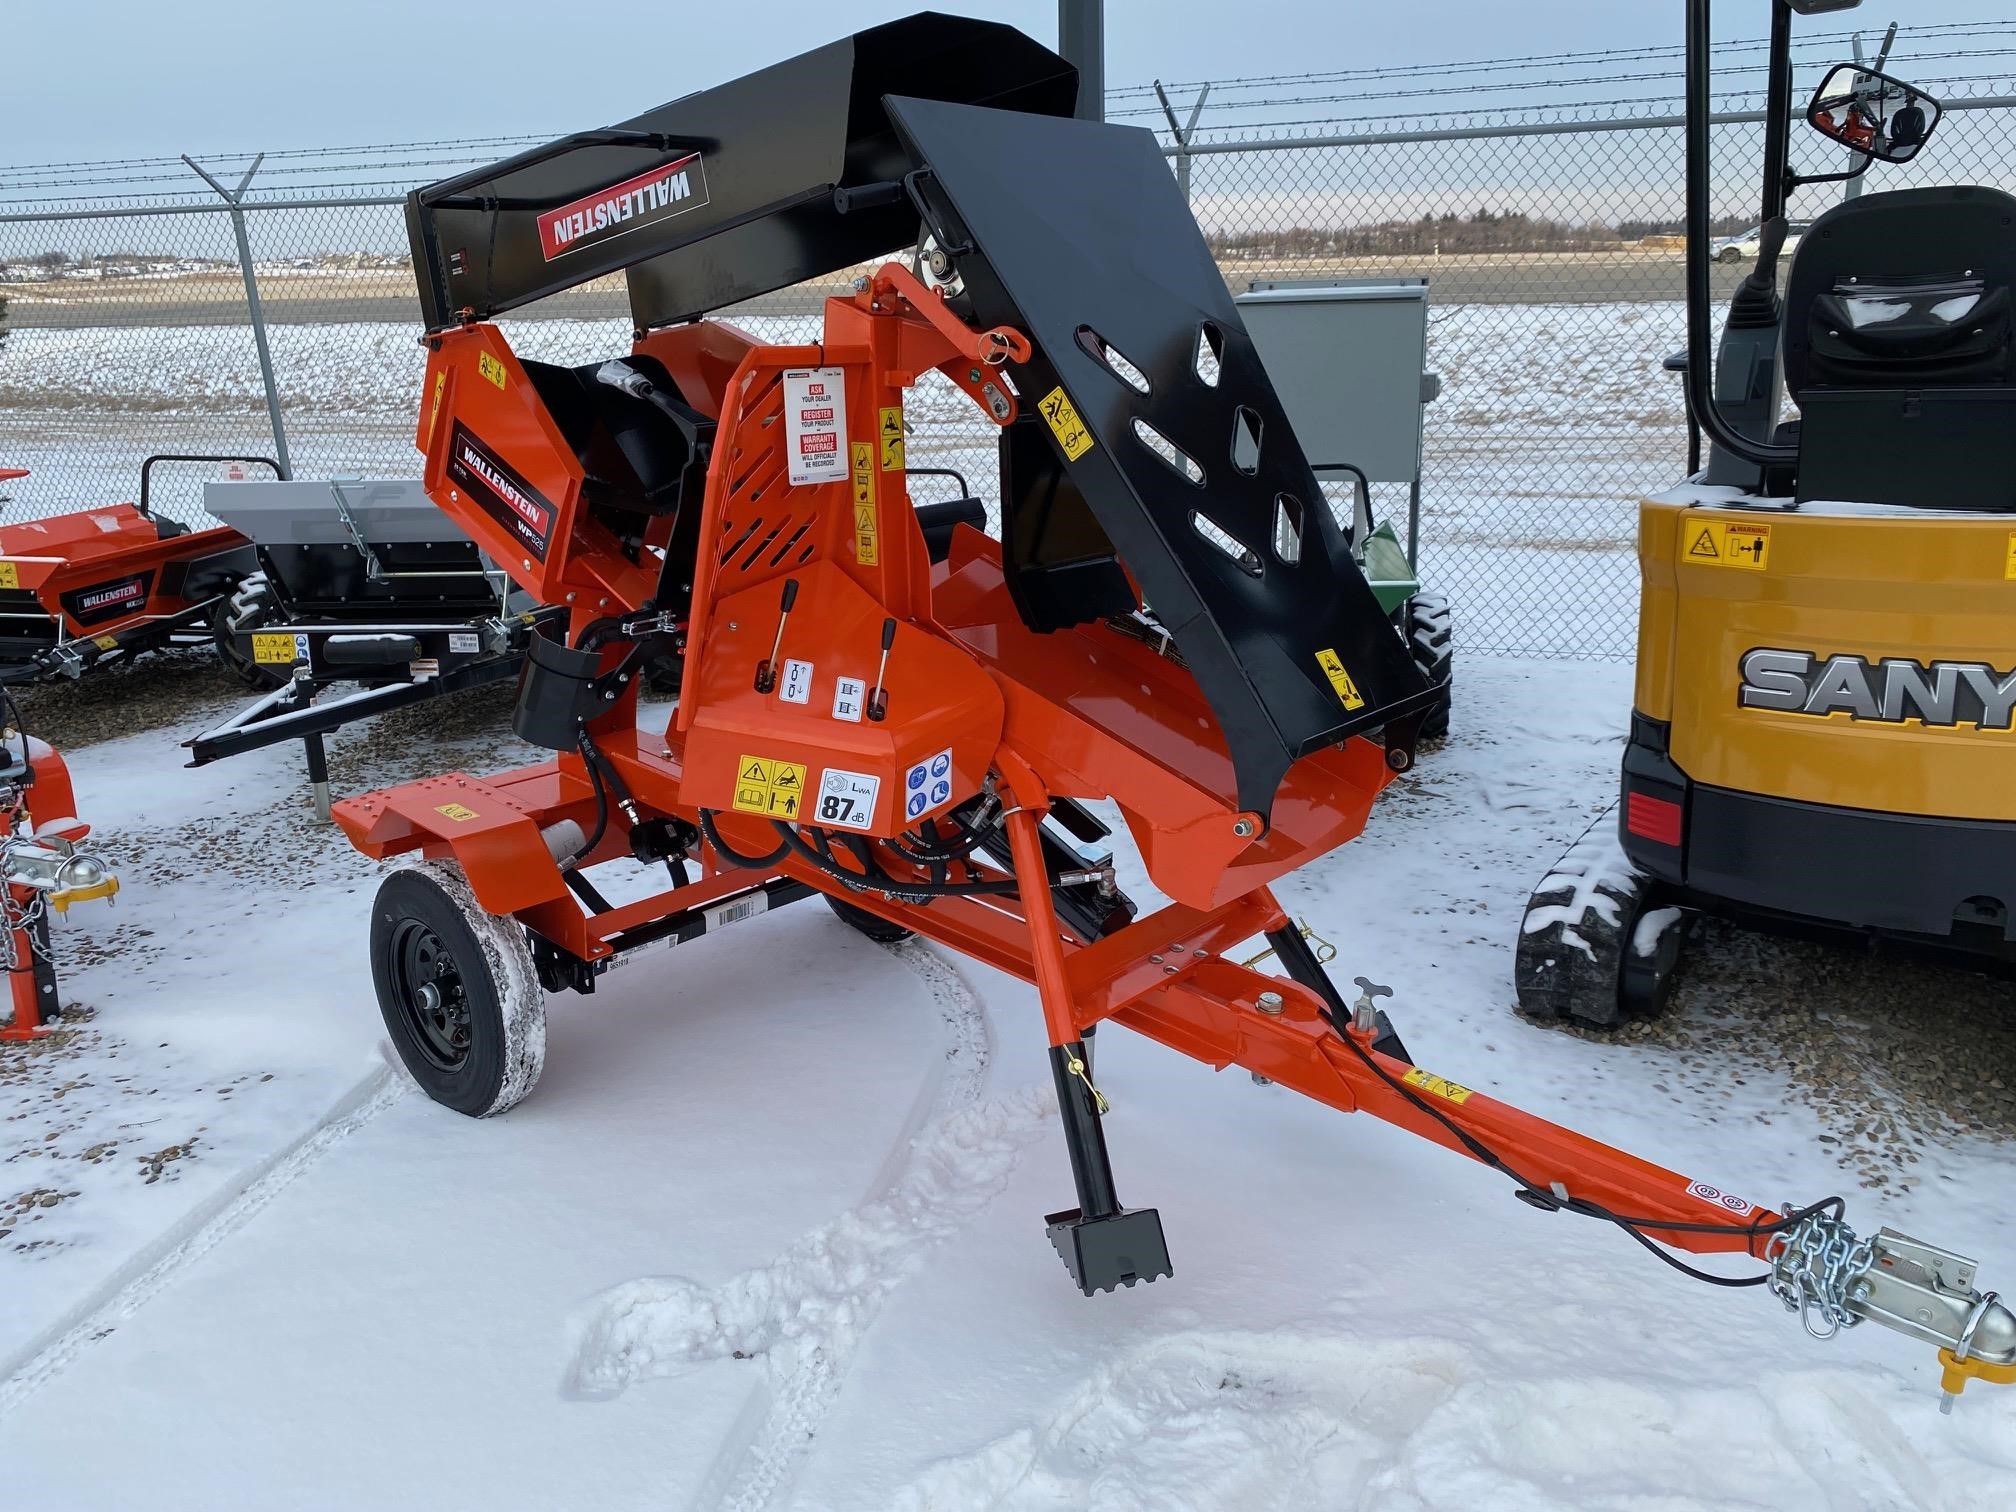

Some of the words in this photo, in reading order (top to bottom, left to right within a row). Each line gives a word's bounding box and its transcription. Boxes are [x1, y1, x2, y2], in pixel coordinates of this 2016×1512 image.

[553, 171, 691, 245] WALLENSTEIN
[810, 385, 823, 394] ASK
[803, 410, 832, 419] REGISTER
[802, 434, 834, 444] WARRANTY
[804, 442, 834, 452] COVERAGE
[812, 460, 834, 468] RECORDED
[464, 446, 540, 523] WALLENSTEIN
[518, 520, 544, 551] WP525
[1737, 526, 1767, 534] WARNING
[83, 585, 137, 608] WALLENSTEIN
[1740, 647, 2016, 729] SANY
[821, 796, 855, 822] 87
[851, 812, 865, 823] dB
